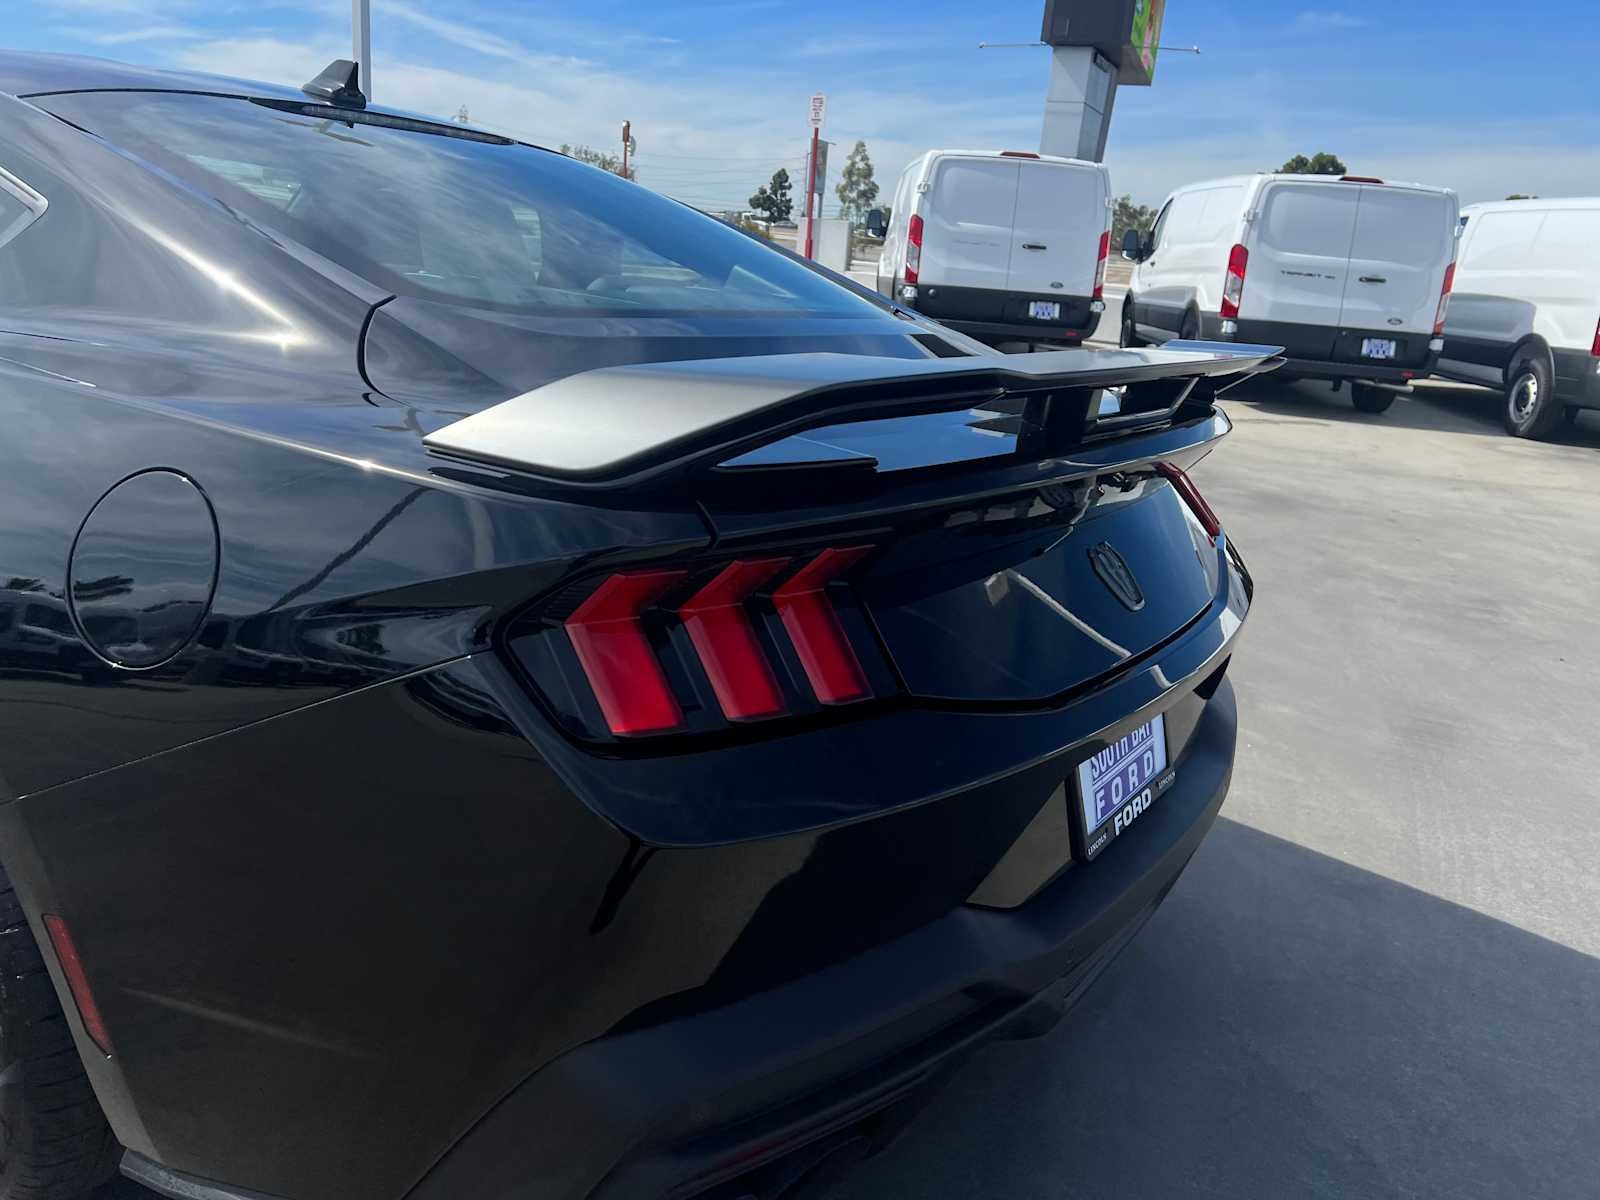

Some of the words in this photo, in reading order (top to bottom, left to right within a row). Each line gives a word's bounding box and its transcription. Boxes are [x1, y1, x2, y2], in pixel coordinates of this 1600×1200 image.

[1095, 750, 1154, 820] FORD
[1087, 833, 1107, 856] LINCOLN
[1113, 787, 1152, 836] FORD
